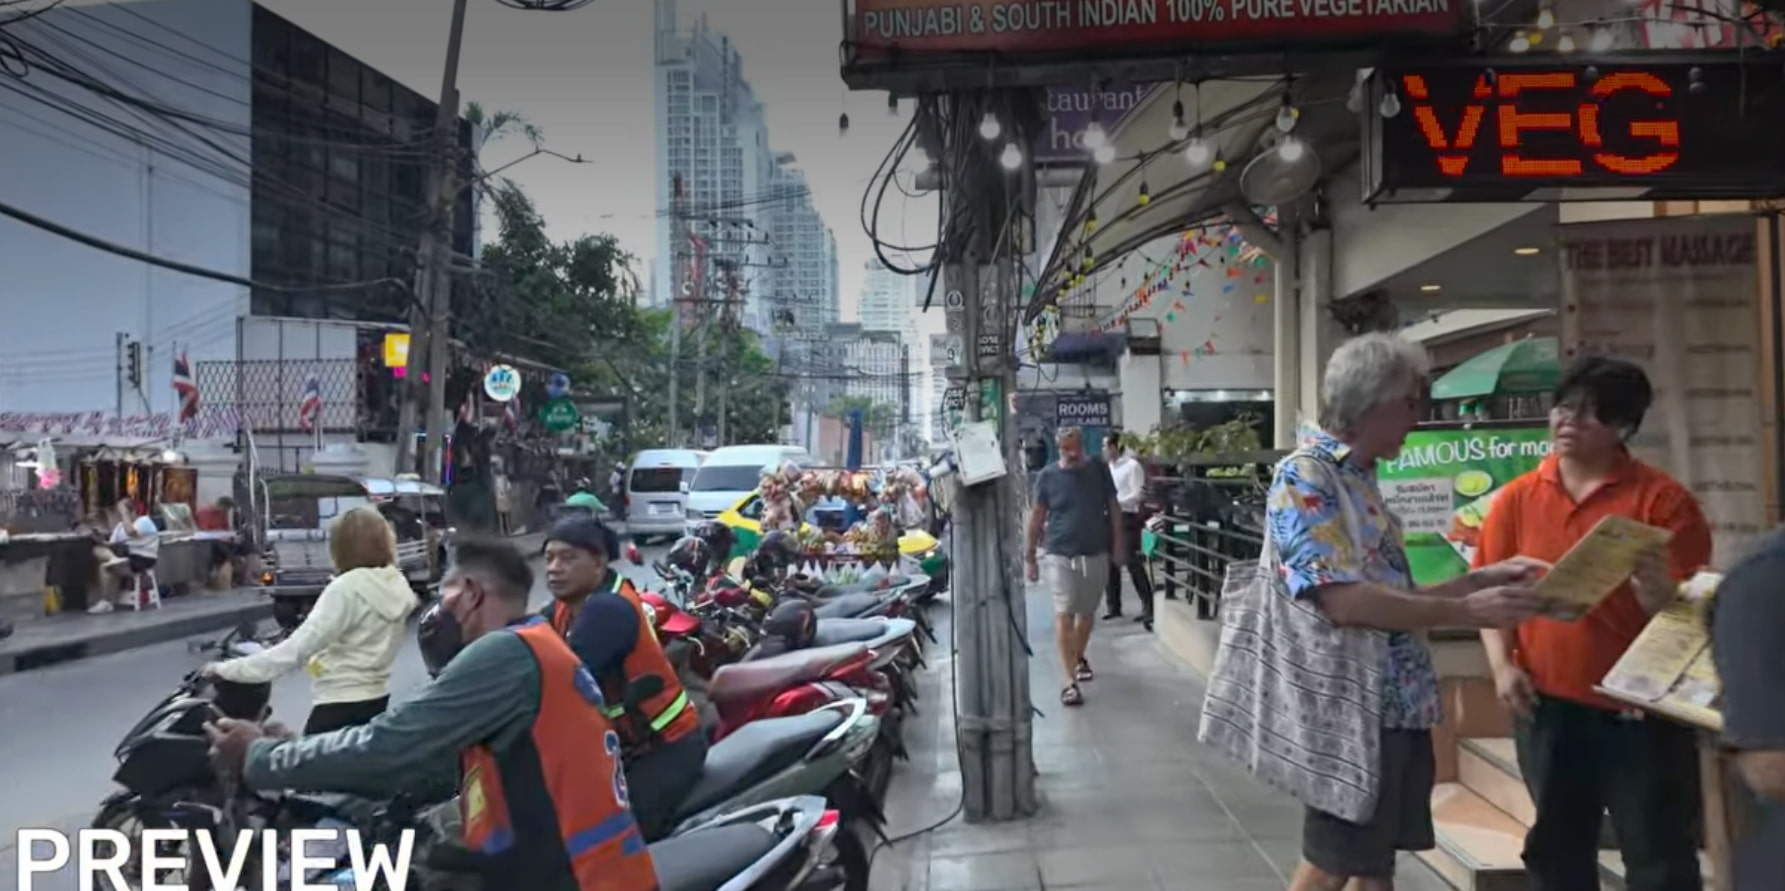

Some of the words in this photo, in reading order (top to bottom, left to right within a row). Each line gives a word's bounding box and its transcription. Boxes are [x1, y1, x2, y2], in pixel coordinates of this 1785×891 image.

[865, 7, 962, 38] PUNJABI
[968, 5, 985, 34] &
[993, 1, 1071, 32] SOUTH
[1079, 0, 1157, 27] INDIAN
[1167, 0, 1224, 22] 100%
[1232, 0, 1295, 19] PURE
[1301, 0, 1449, 16] VEGETARIAN
[1403, 72, 1680, 177] VEG
[1059, 402, 1108, 416] ROOMS
[1386, 437, 1486, 473] FAMOUS
[1488, 436, 1517, 458] for
